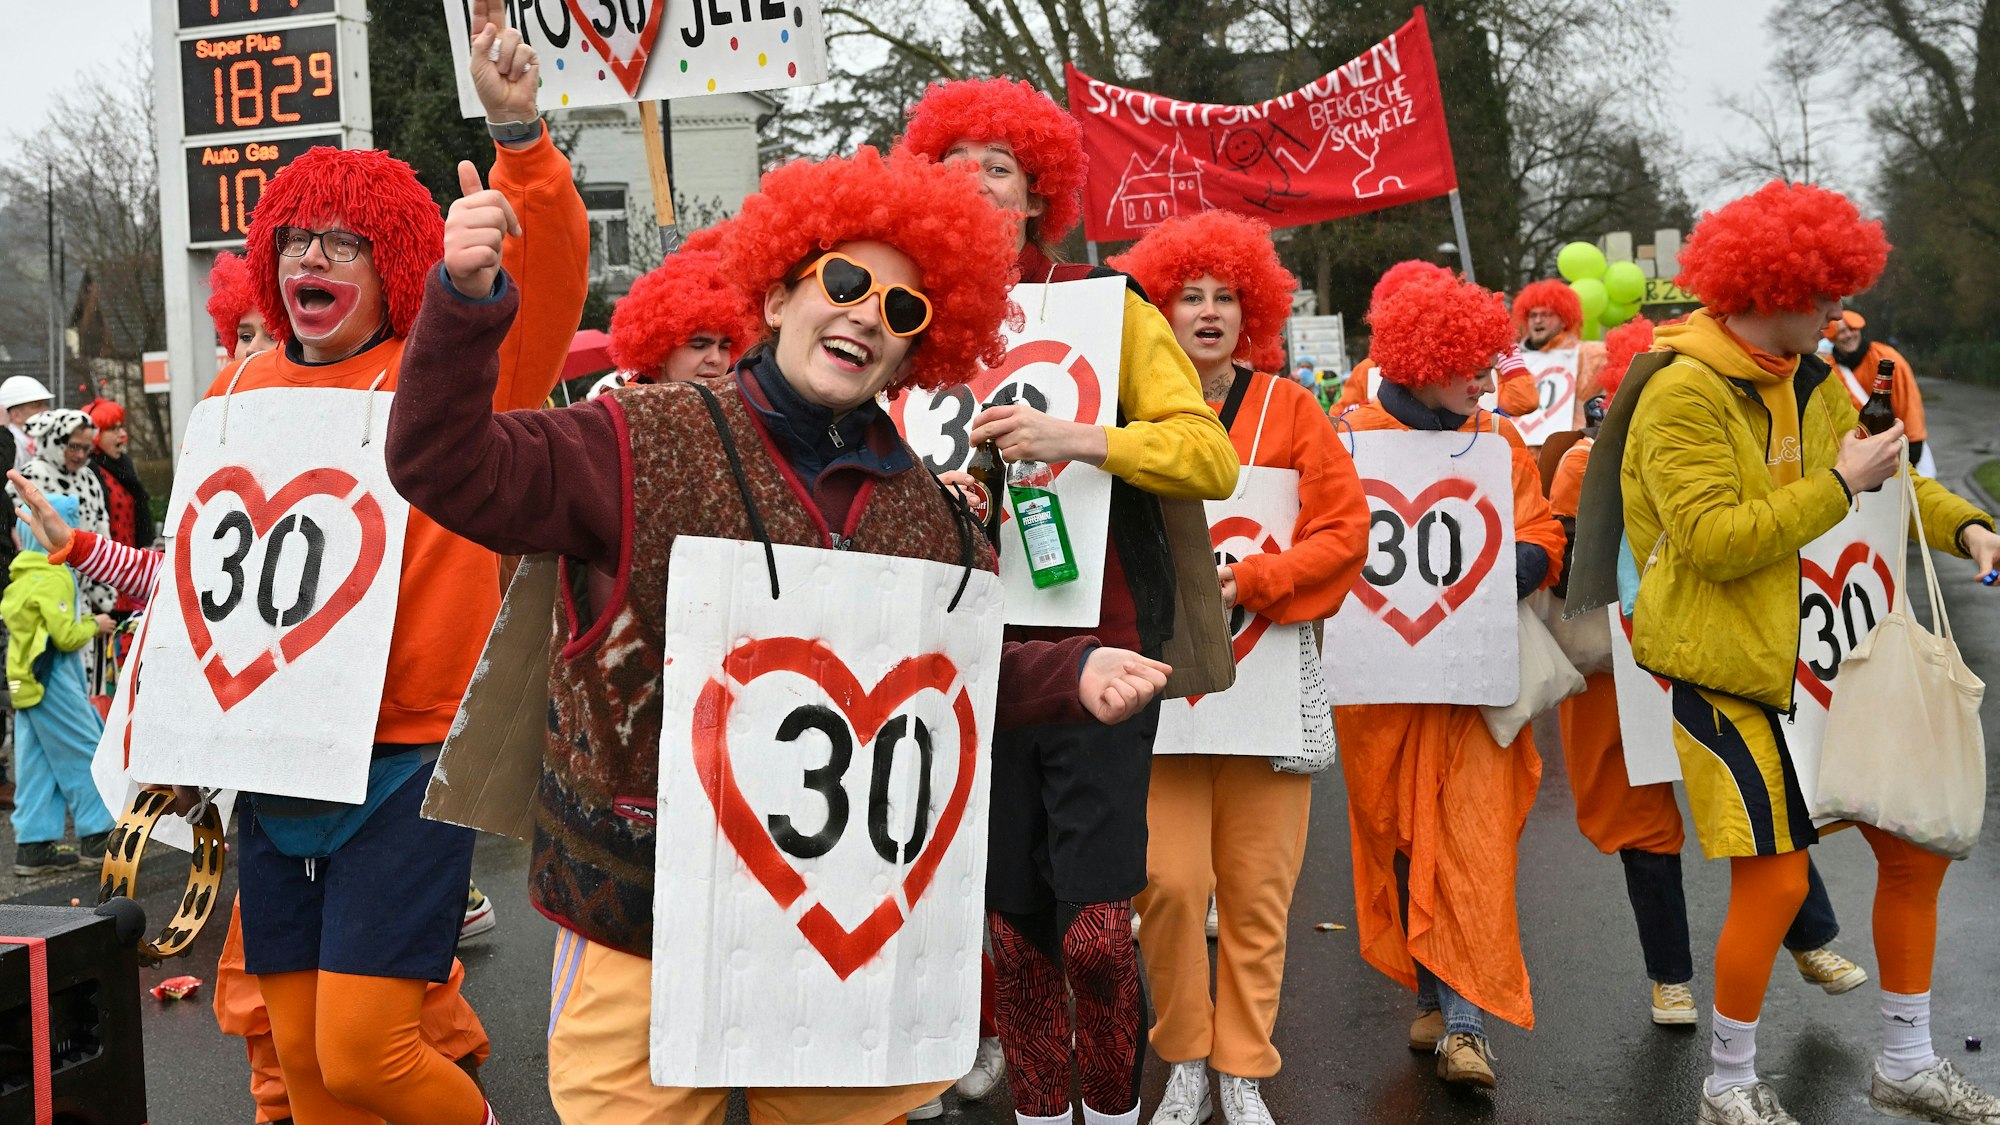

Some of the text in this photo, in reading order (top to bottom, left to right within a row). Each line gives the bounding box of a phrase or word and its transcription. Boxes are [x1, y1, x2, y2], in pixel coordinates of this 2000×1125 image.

[196, 33, 282, 60] Super Plus
[1308, 74, 1412, 130] BERGISCHE
[1331, 100, 1417, 151] SCHWEIZ
[202, 142, 279, 165] Auto Gas
[219, 165, 287, 235] 10
[201, 510, 326, 627] 30
[1361, 509, 1462, 587] 30
[1801, 581, 1877, 681] 30
[767, 703, 933, 866] 30
